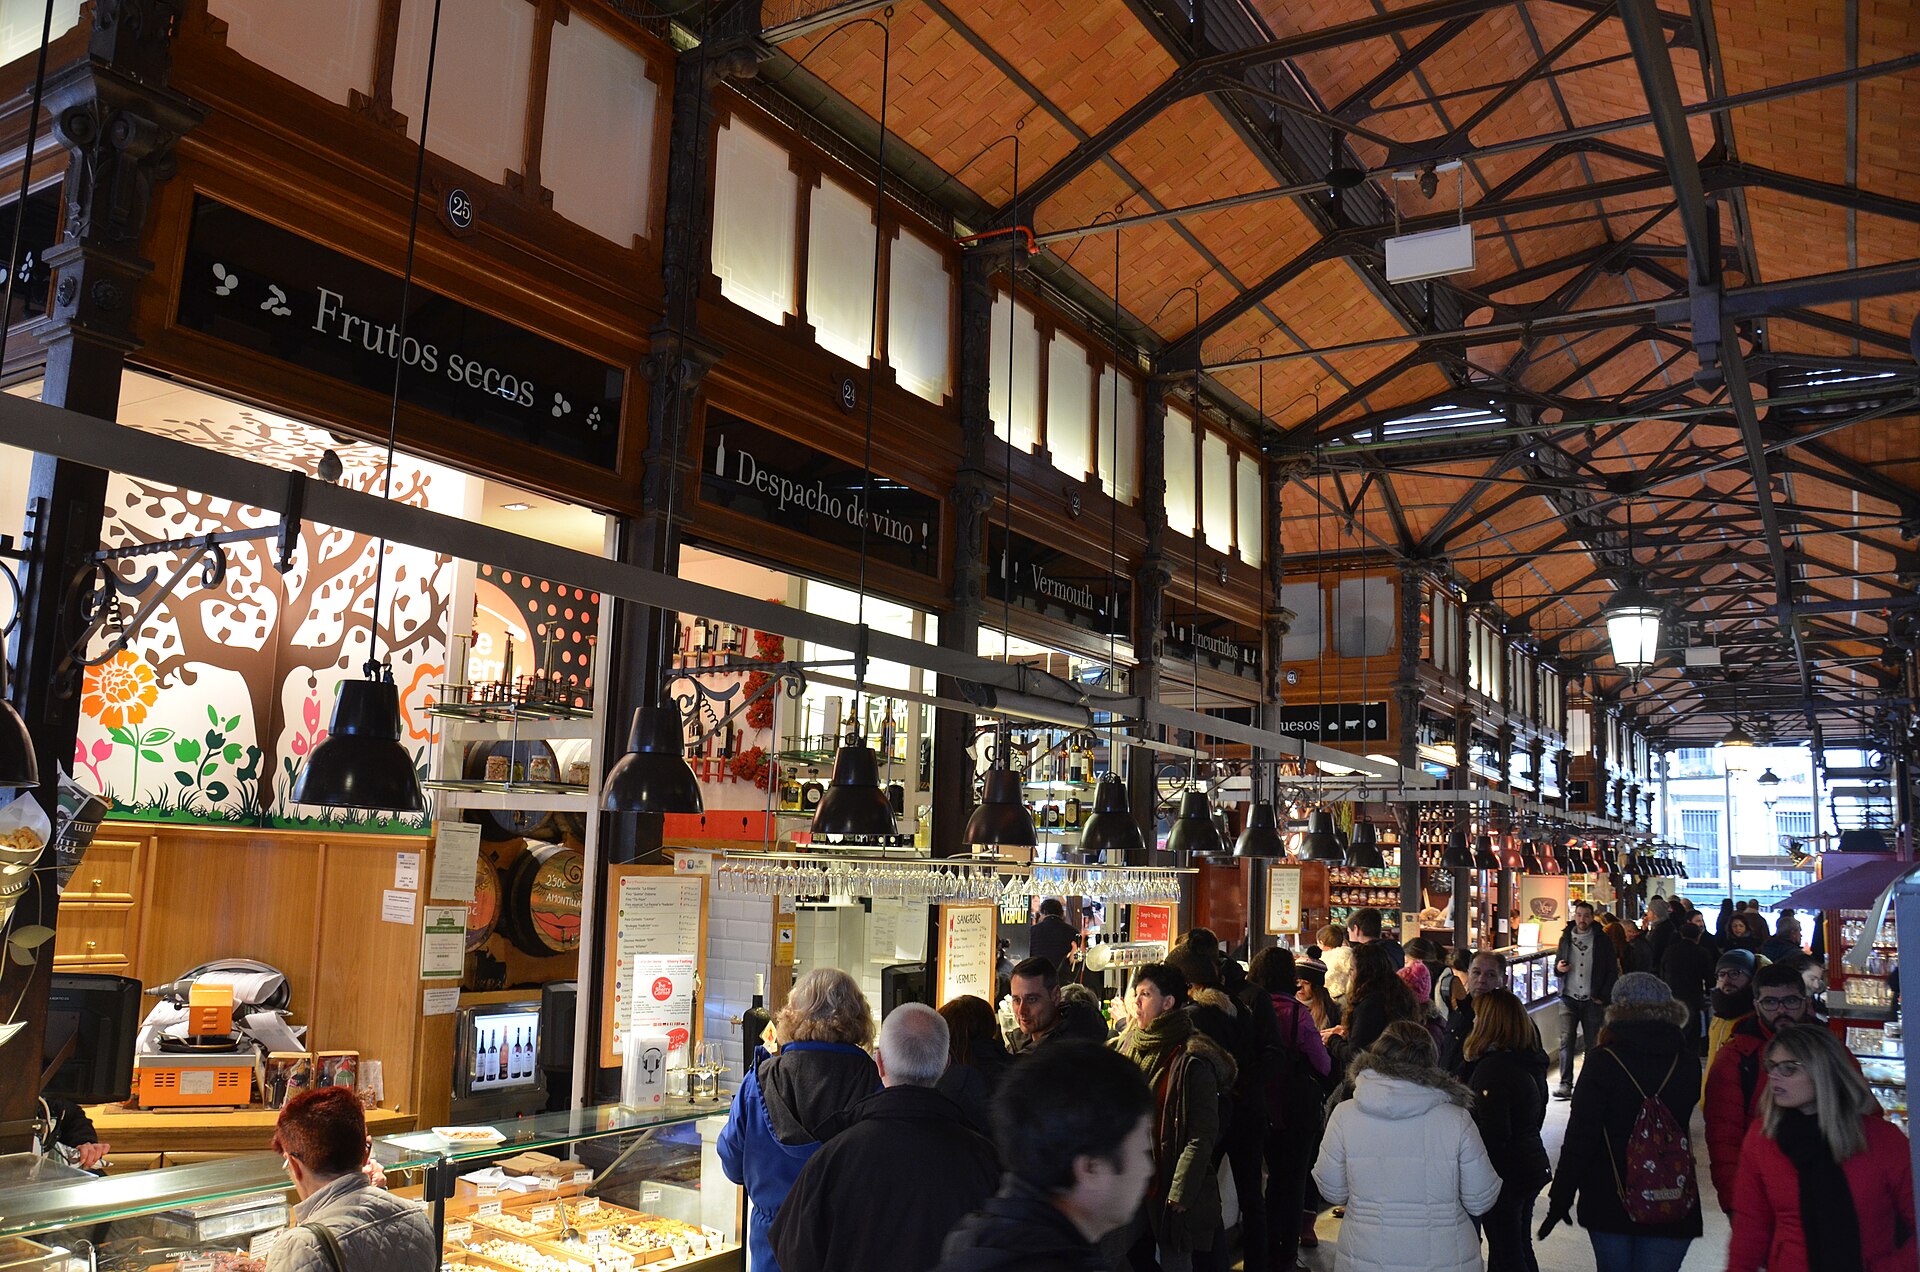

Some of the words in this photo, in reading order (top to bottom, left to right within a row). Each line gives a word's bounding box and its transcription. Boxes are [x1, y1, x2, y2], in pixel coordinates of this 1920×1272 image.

[453, 197, 470, 219] 25
[312, 286, 438, 372] Frutos
[447, 354, 535, 407] secos
[845, 385, 855, 401] 24
[736, 450, 841, 519] Despacho
[847, 495, 868, 527] de
[872, 509, 913, 544] vino
[1031, 563, 1094, 610] Vermouth
[1190, 624, 1239, 660] Encurtidos
[1280, 719, 1320, 731] uesos
[545, 874, 567, 889] 2'50€
[1007, 894, 1024, 908] HORA
[956, 913, 981, 925] SANGRÍAS
[1000, 907, 1029, 924] VERMUT
[956, 974, 977, 984] VERMUTS
